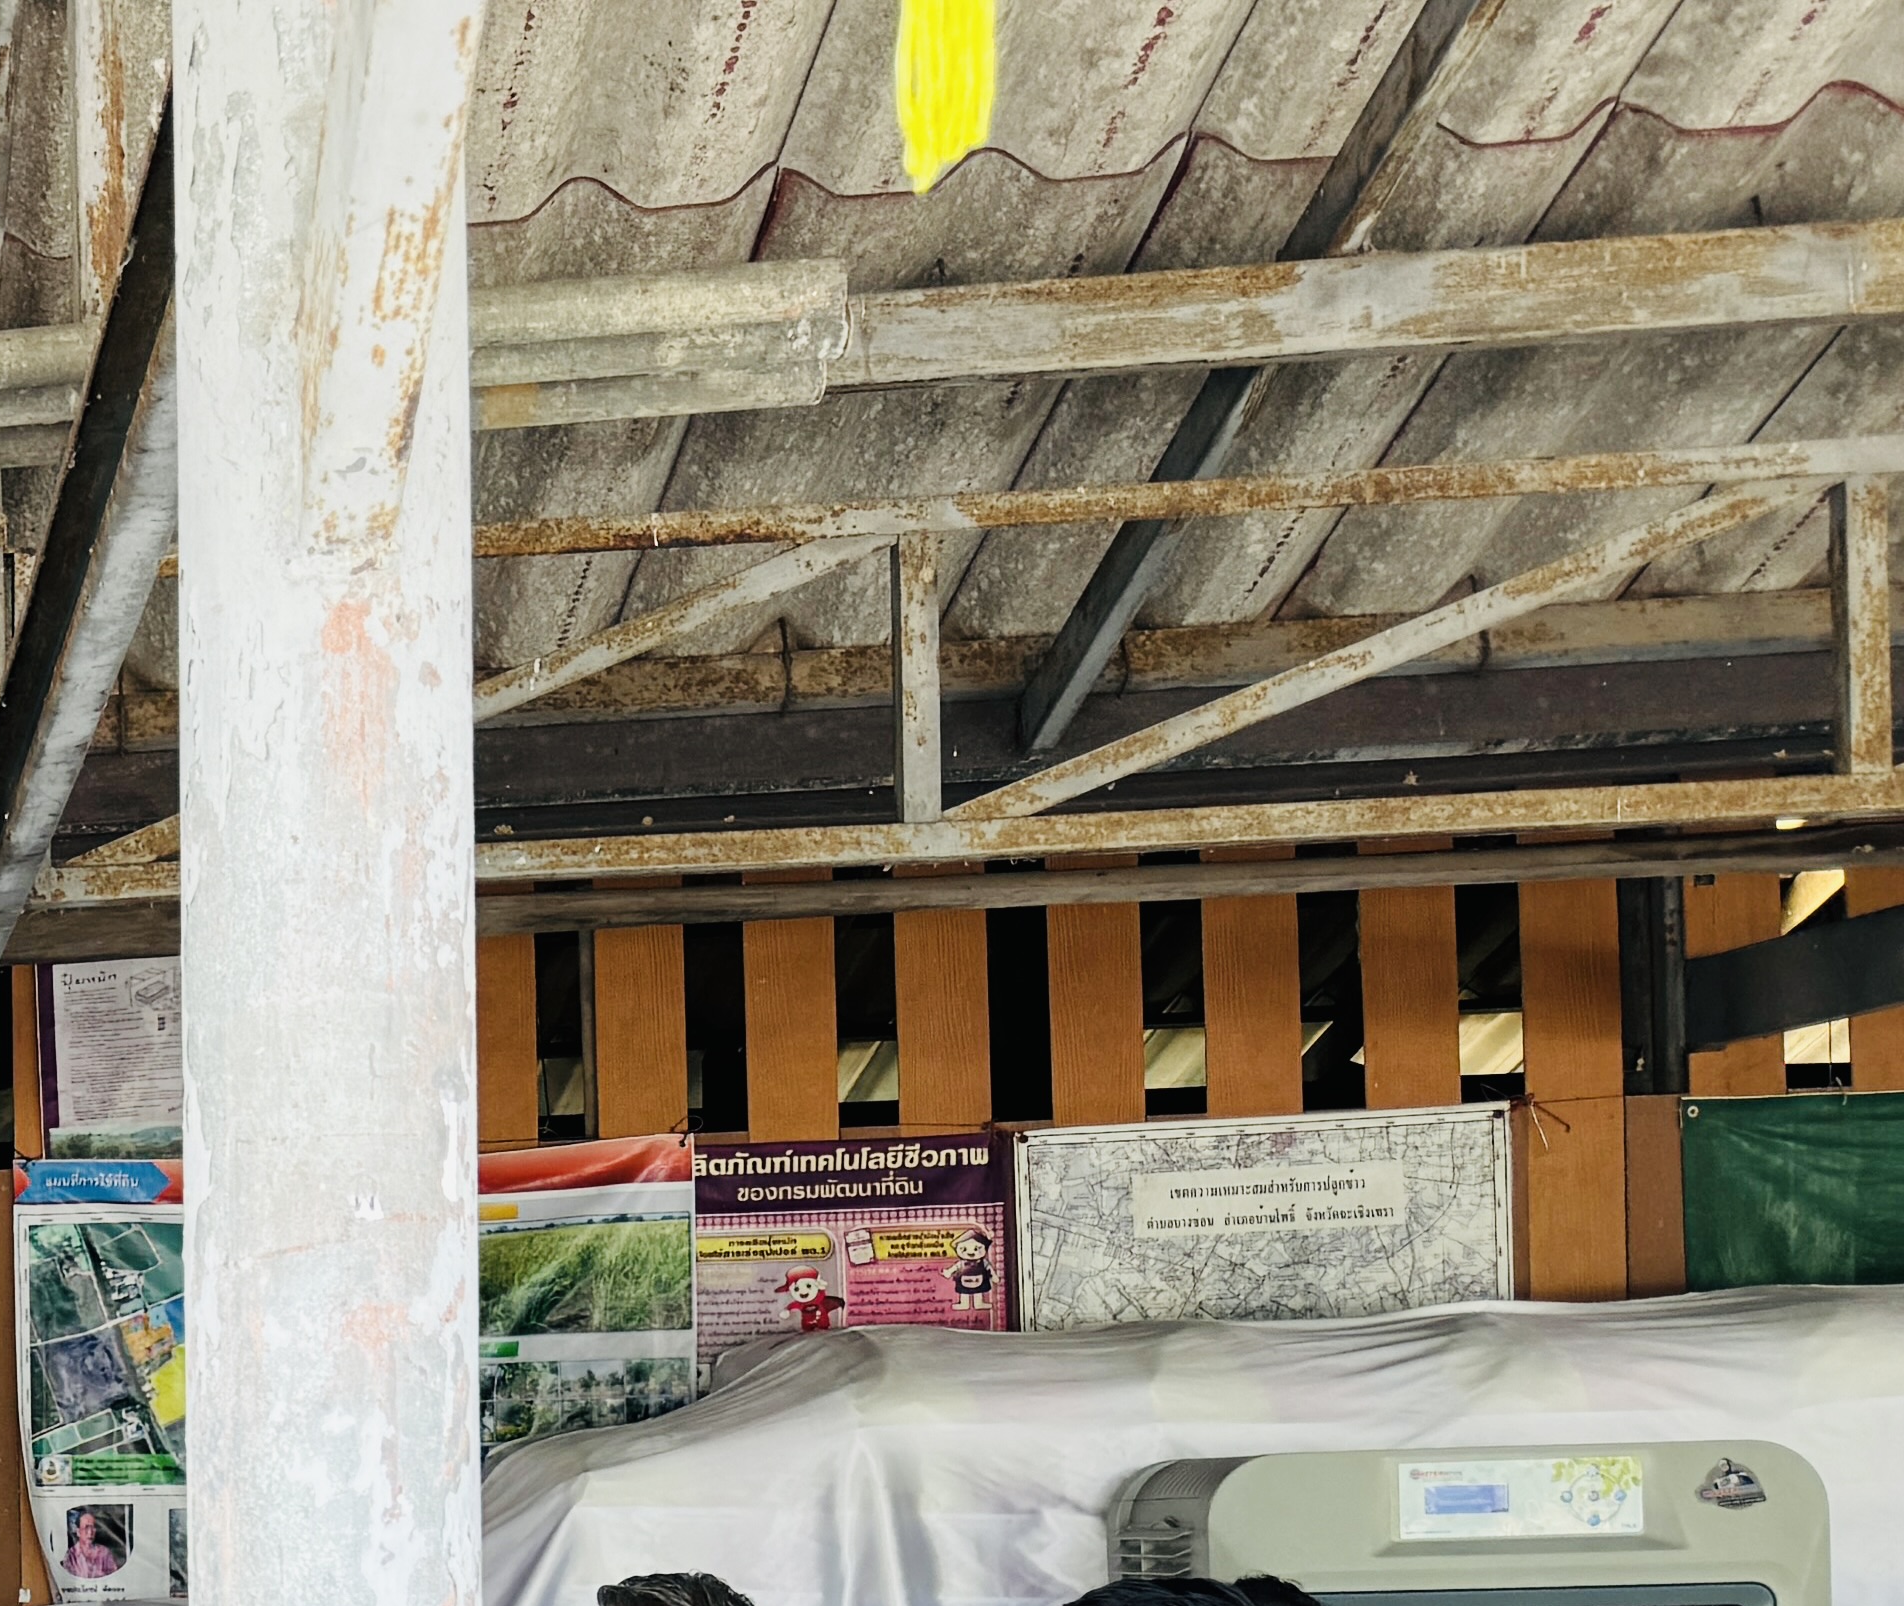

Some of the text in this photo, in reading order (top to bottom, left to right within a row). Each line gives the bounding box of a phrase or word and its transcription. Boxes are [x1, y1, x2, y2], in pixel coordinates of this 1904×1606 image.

[694, 1142, 989, 1178] ลิตภัณฑ์เทคโนโลยีชีวภาพ
[737, 1170, 924, 1202] ของกรมพัฒนาที่ดิน
